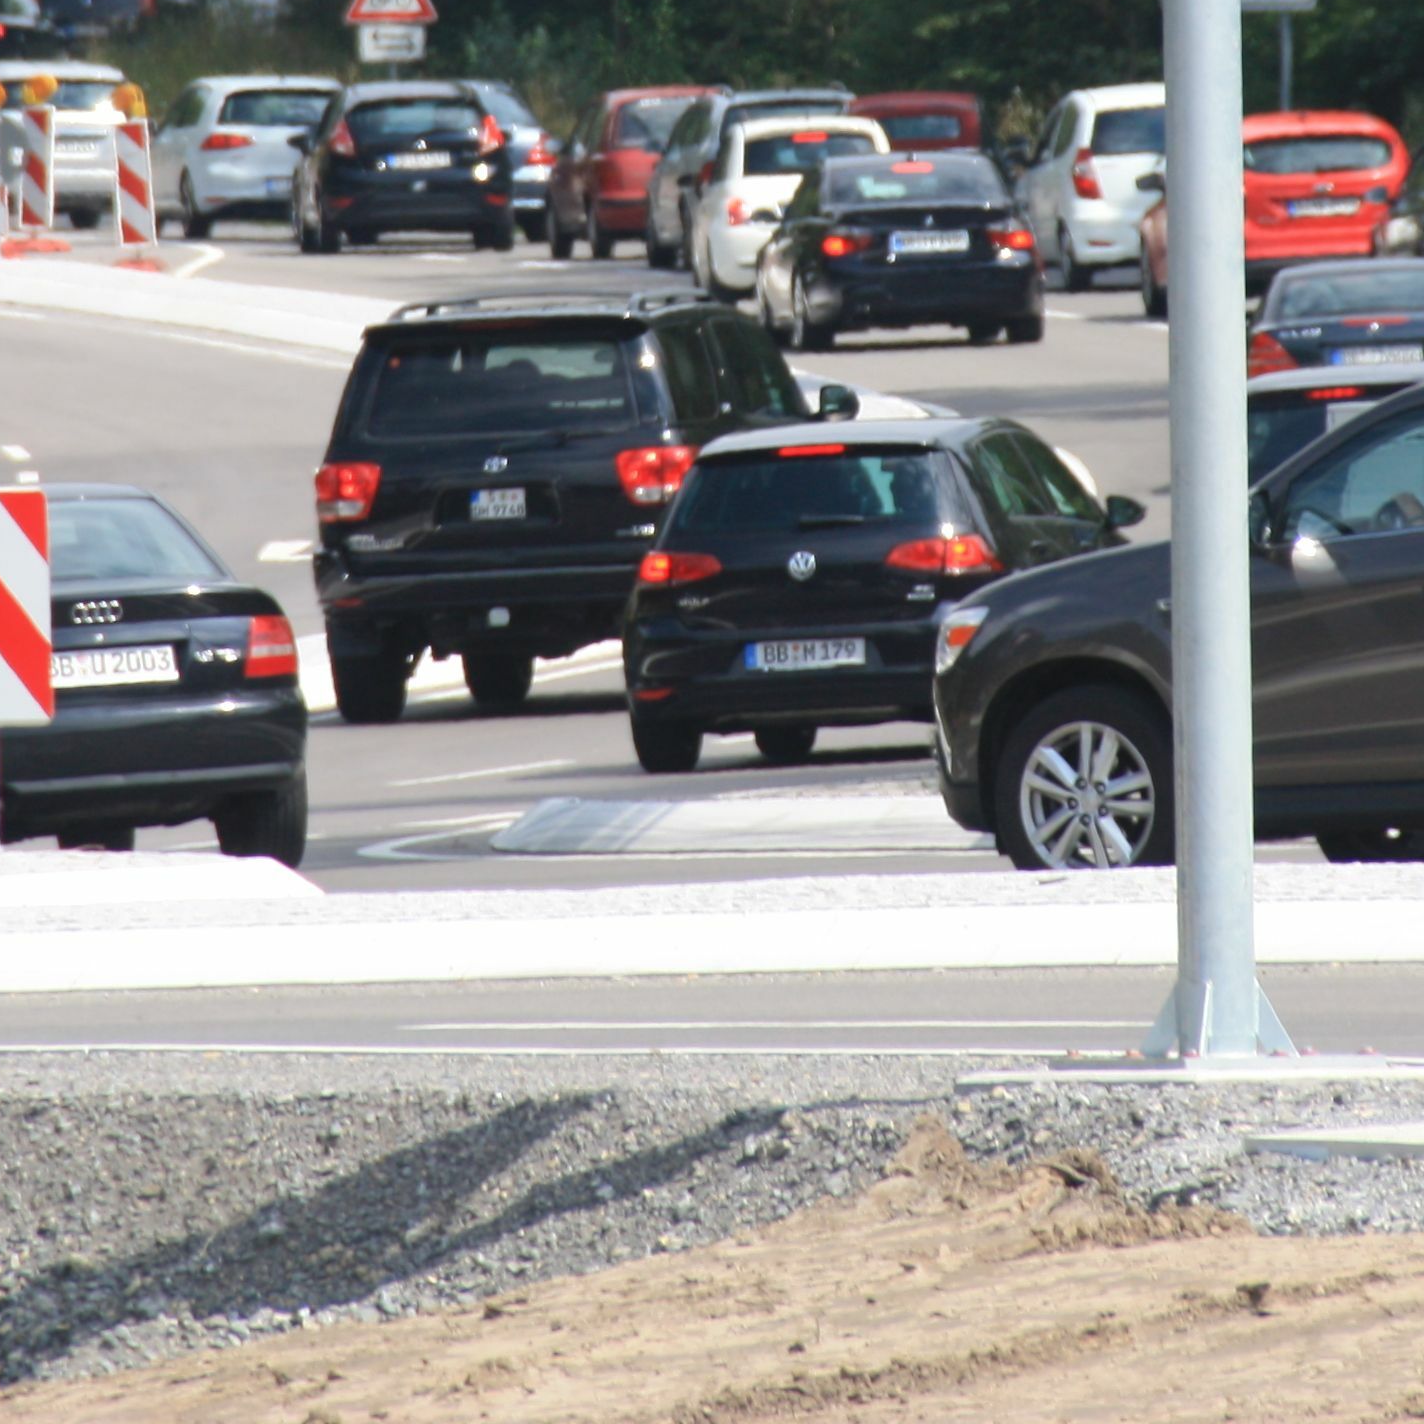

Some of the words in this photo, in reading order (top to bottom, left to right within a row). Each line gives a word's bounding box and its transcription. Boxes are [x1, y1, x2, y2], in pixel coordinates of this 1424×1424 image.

[112, 649, 171, 673] 2003
[763, 645, 789, 663] BB
[820, 640, 857, 660] 179
